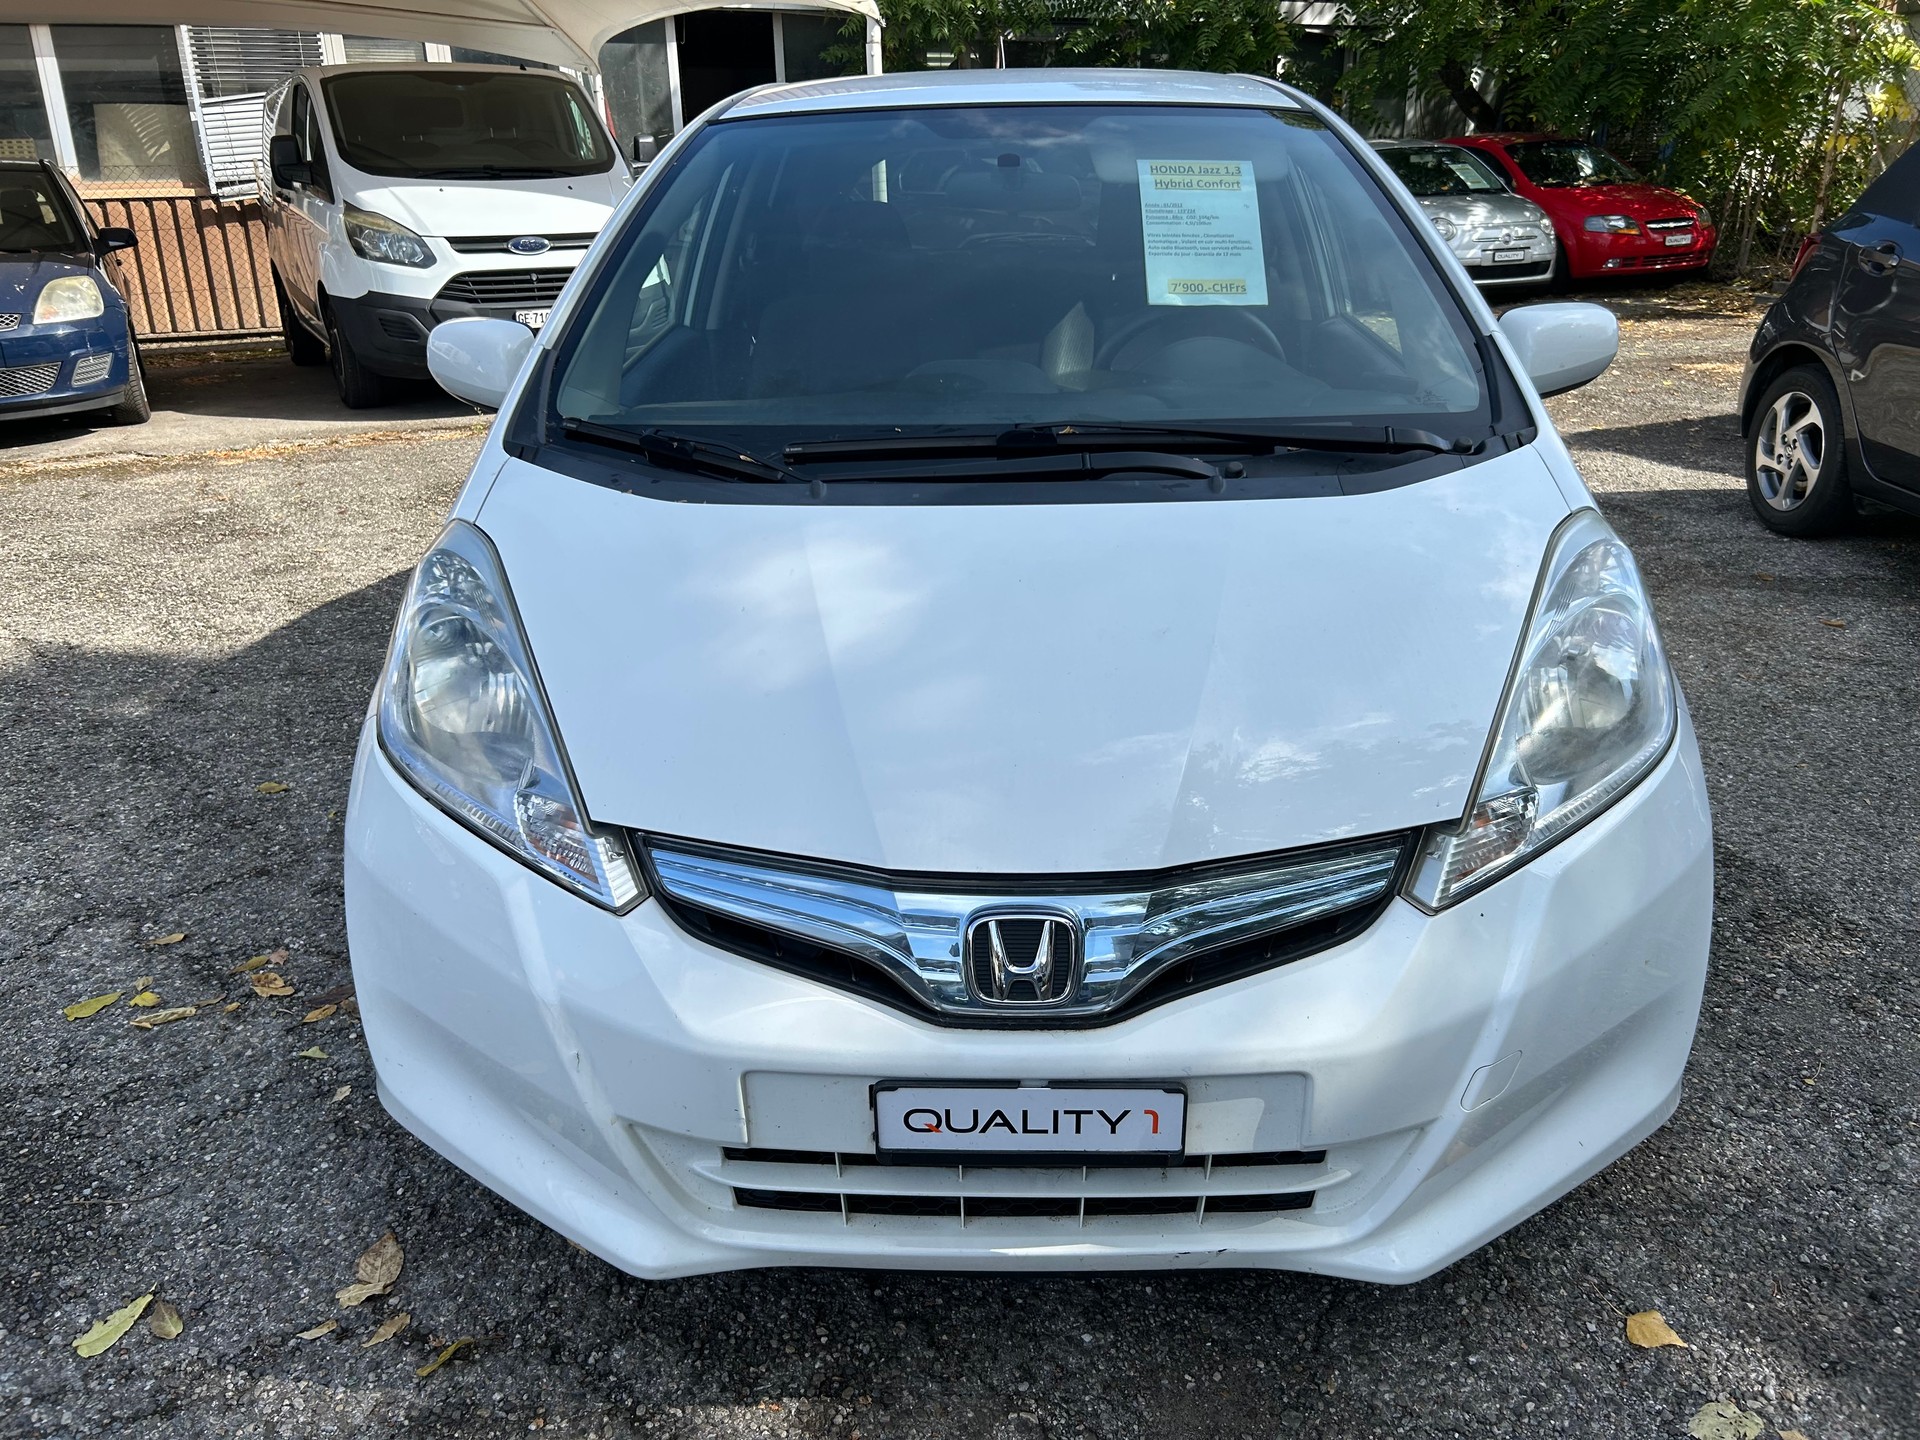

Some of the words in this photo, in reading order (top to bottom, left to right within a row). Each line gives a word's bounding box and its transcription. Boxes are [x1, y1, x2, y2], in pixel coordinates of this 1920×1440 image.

[1150, 165, 1195, 174] HONDA
[1198, 165, 1221, 174] Jazz
[1225, 166, 1242, 175] 1,3
[1154, 179, 1193, 189] Hybrid
[1196, 179, 1241, 189] Confort
[902, 1107, 1132, 1135] QUALITY
